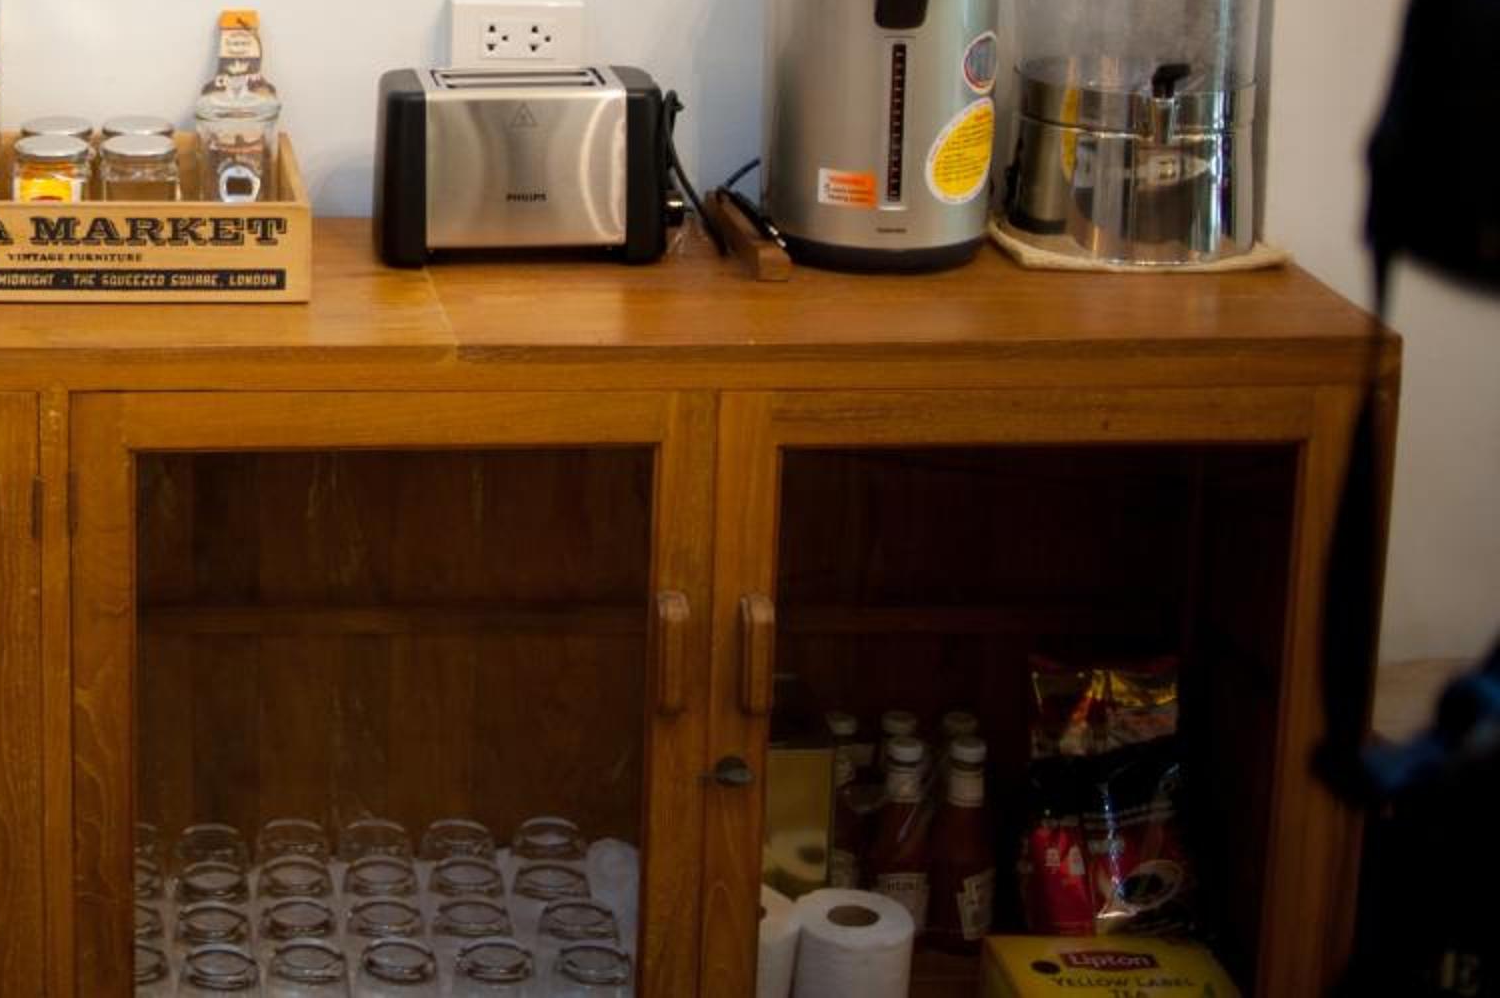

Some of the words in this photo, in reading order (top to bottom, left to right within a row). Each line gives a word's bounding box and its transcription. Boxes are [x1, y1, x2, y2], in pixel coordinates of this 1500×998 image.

[30, 216, 287, 247] MARKET
[72, 273, 97, 286] THE
[229, 273, 277, 286] LONDON
[1068, 952, 1151, 969] Lipton
